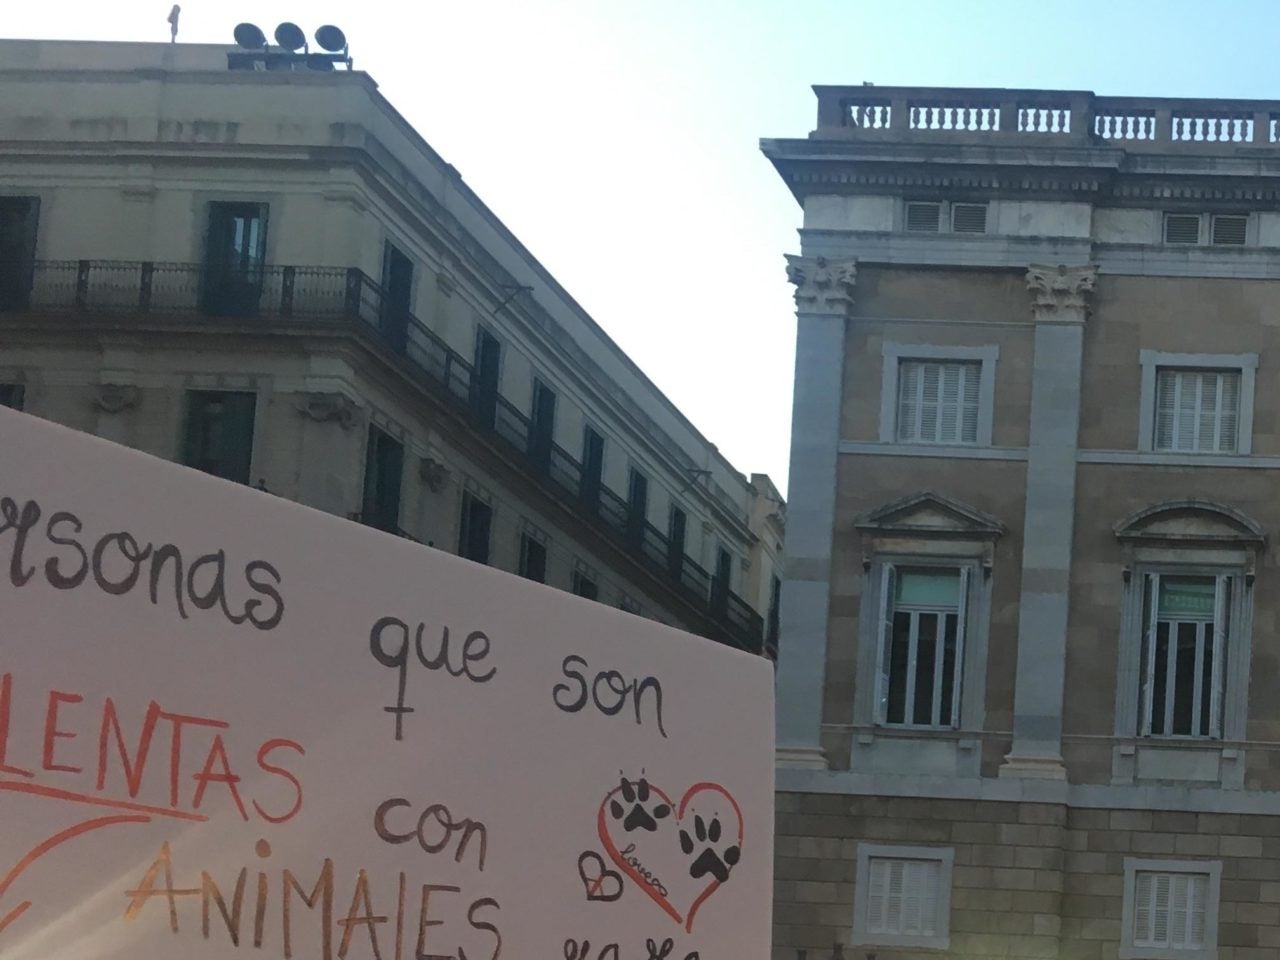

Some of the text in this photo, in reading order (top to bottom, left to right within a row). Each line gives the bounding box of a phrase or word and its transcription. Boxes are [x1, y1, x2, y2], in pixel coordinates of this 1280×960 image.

[369, 616, 497, 741] que
[553, 655, 667, 738] son
[373, 798, 488, 871] con
